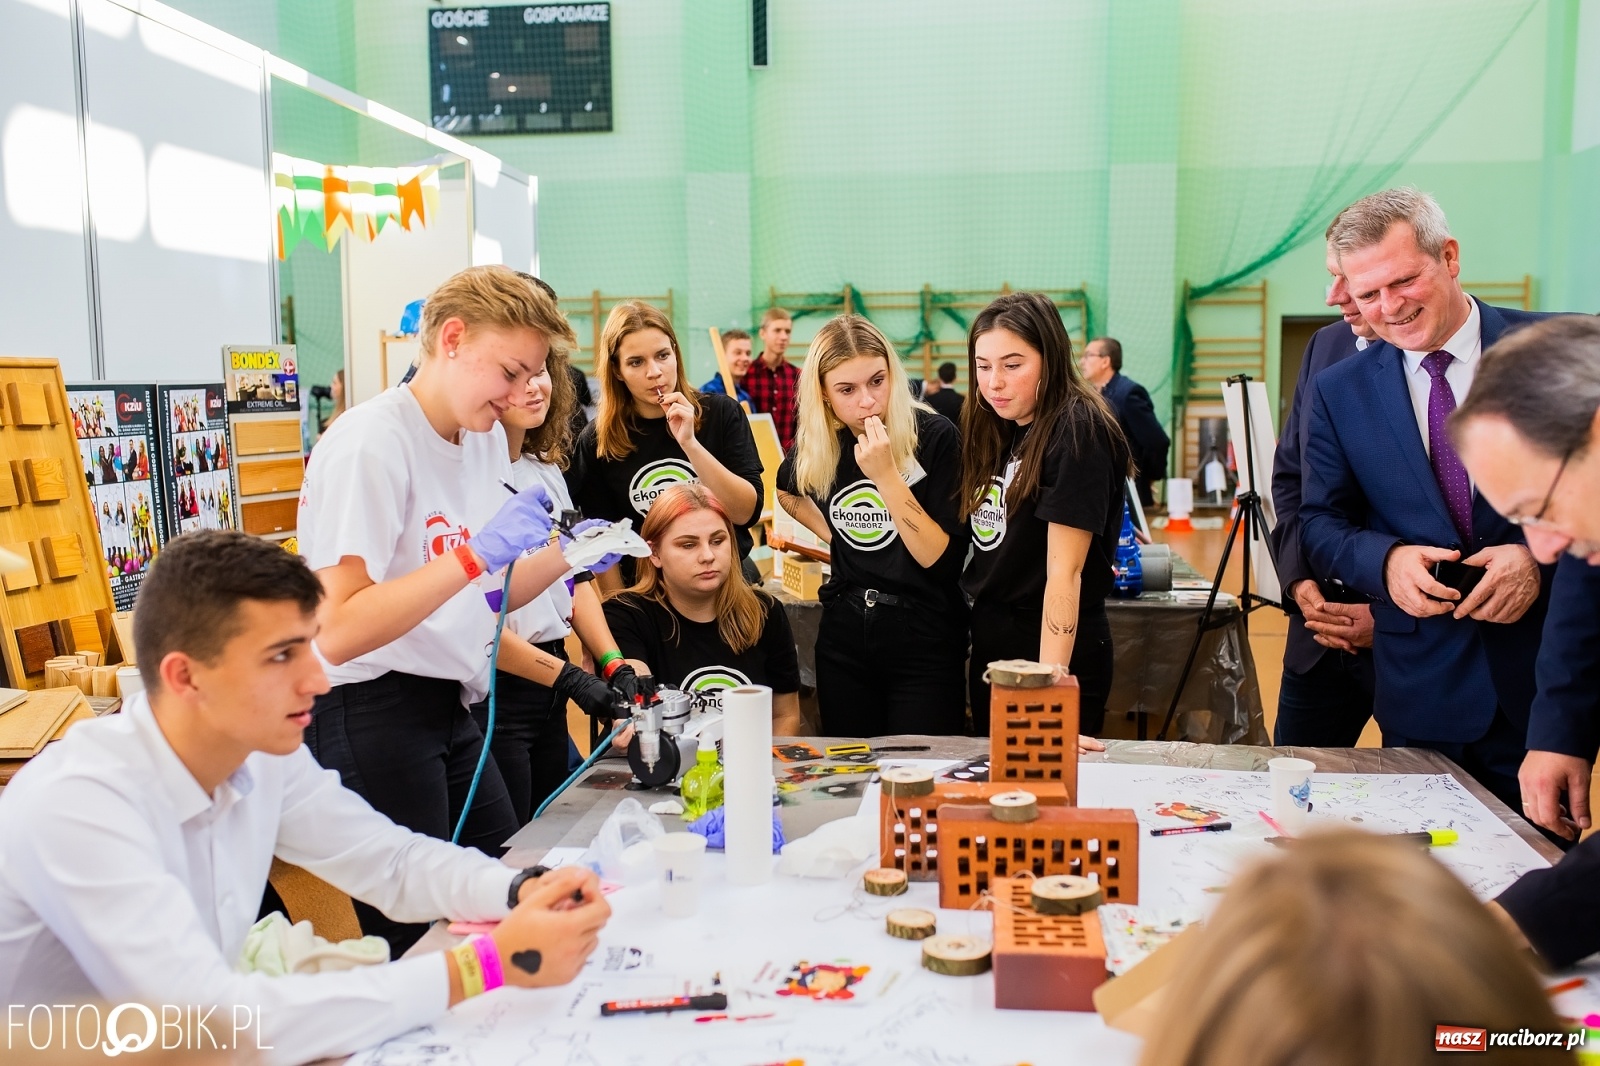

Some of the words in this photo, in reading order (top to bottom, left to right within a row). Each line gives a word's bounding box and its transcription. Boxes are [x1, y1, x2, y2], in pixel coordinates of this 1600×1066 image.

[431, 8, 489, 28] GOŚCIE
[523, 4, 609, 24] GOSPODARZE
[494, 104, 502, 115] 2
[539, 102, 548, 113] 3
[584, 101, 593, 111] 4
[230, 350, 281, 369] BONDEX
[157, 509, 165, 550] WODOWEGO
